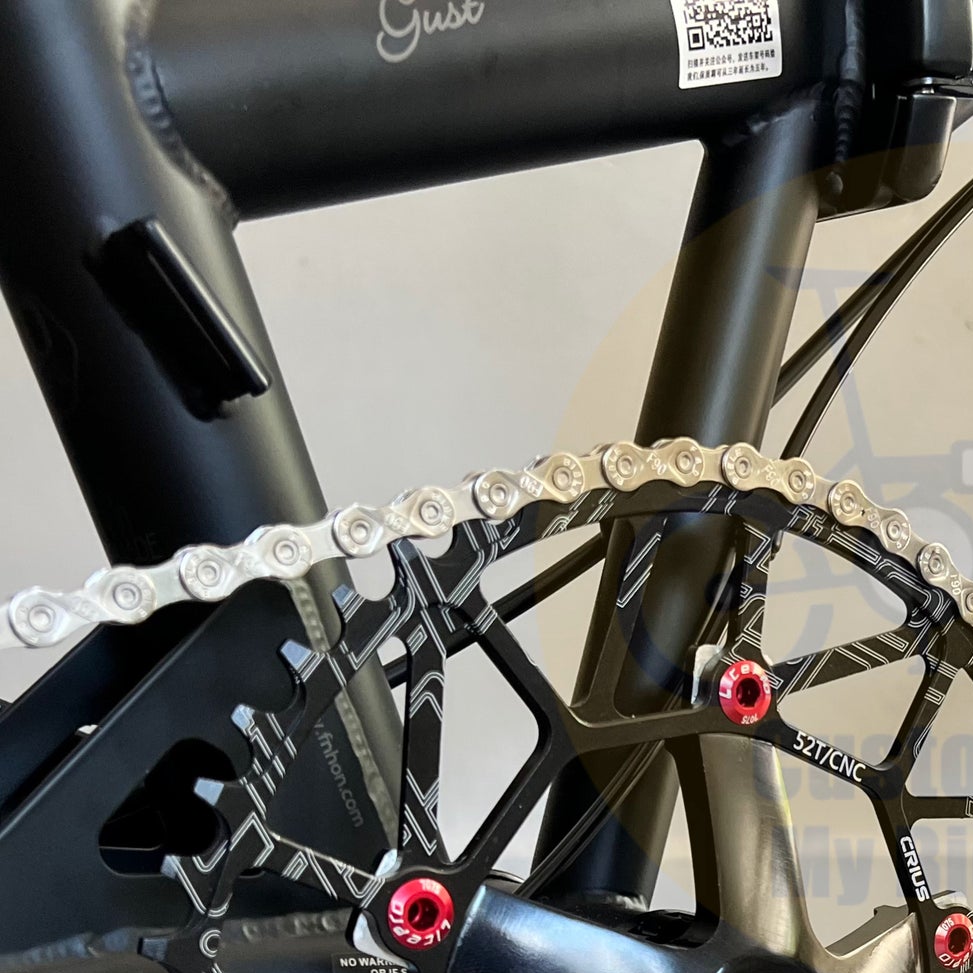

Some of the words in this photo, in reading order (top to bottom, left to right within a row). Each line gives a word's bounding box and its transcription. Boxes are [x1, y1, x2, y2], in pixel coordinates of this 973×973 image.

[377, 0, 485, 62] Gust
[793, 730, 866, 782] 52T/CNC
[900, 835, 930, 902] CRIUS
[340, 958, 357, 967] NO
